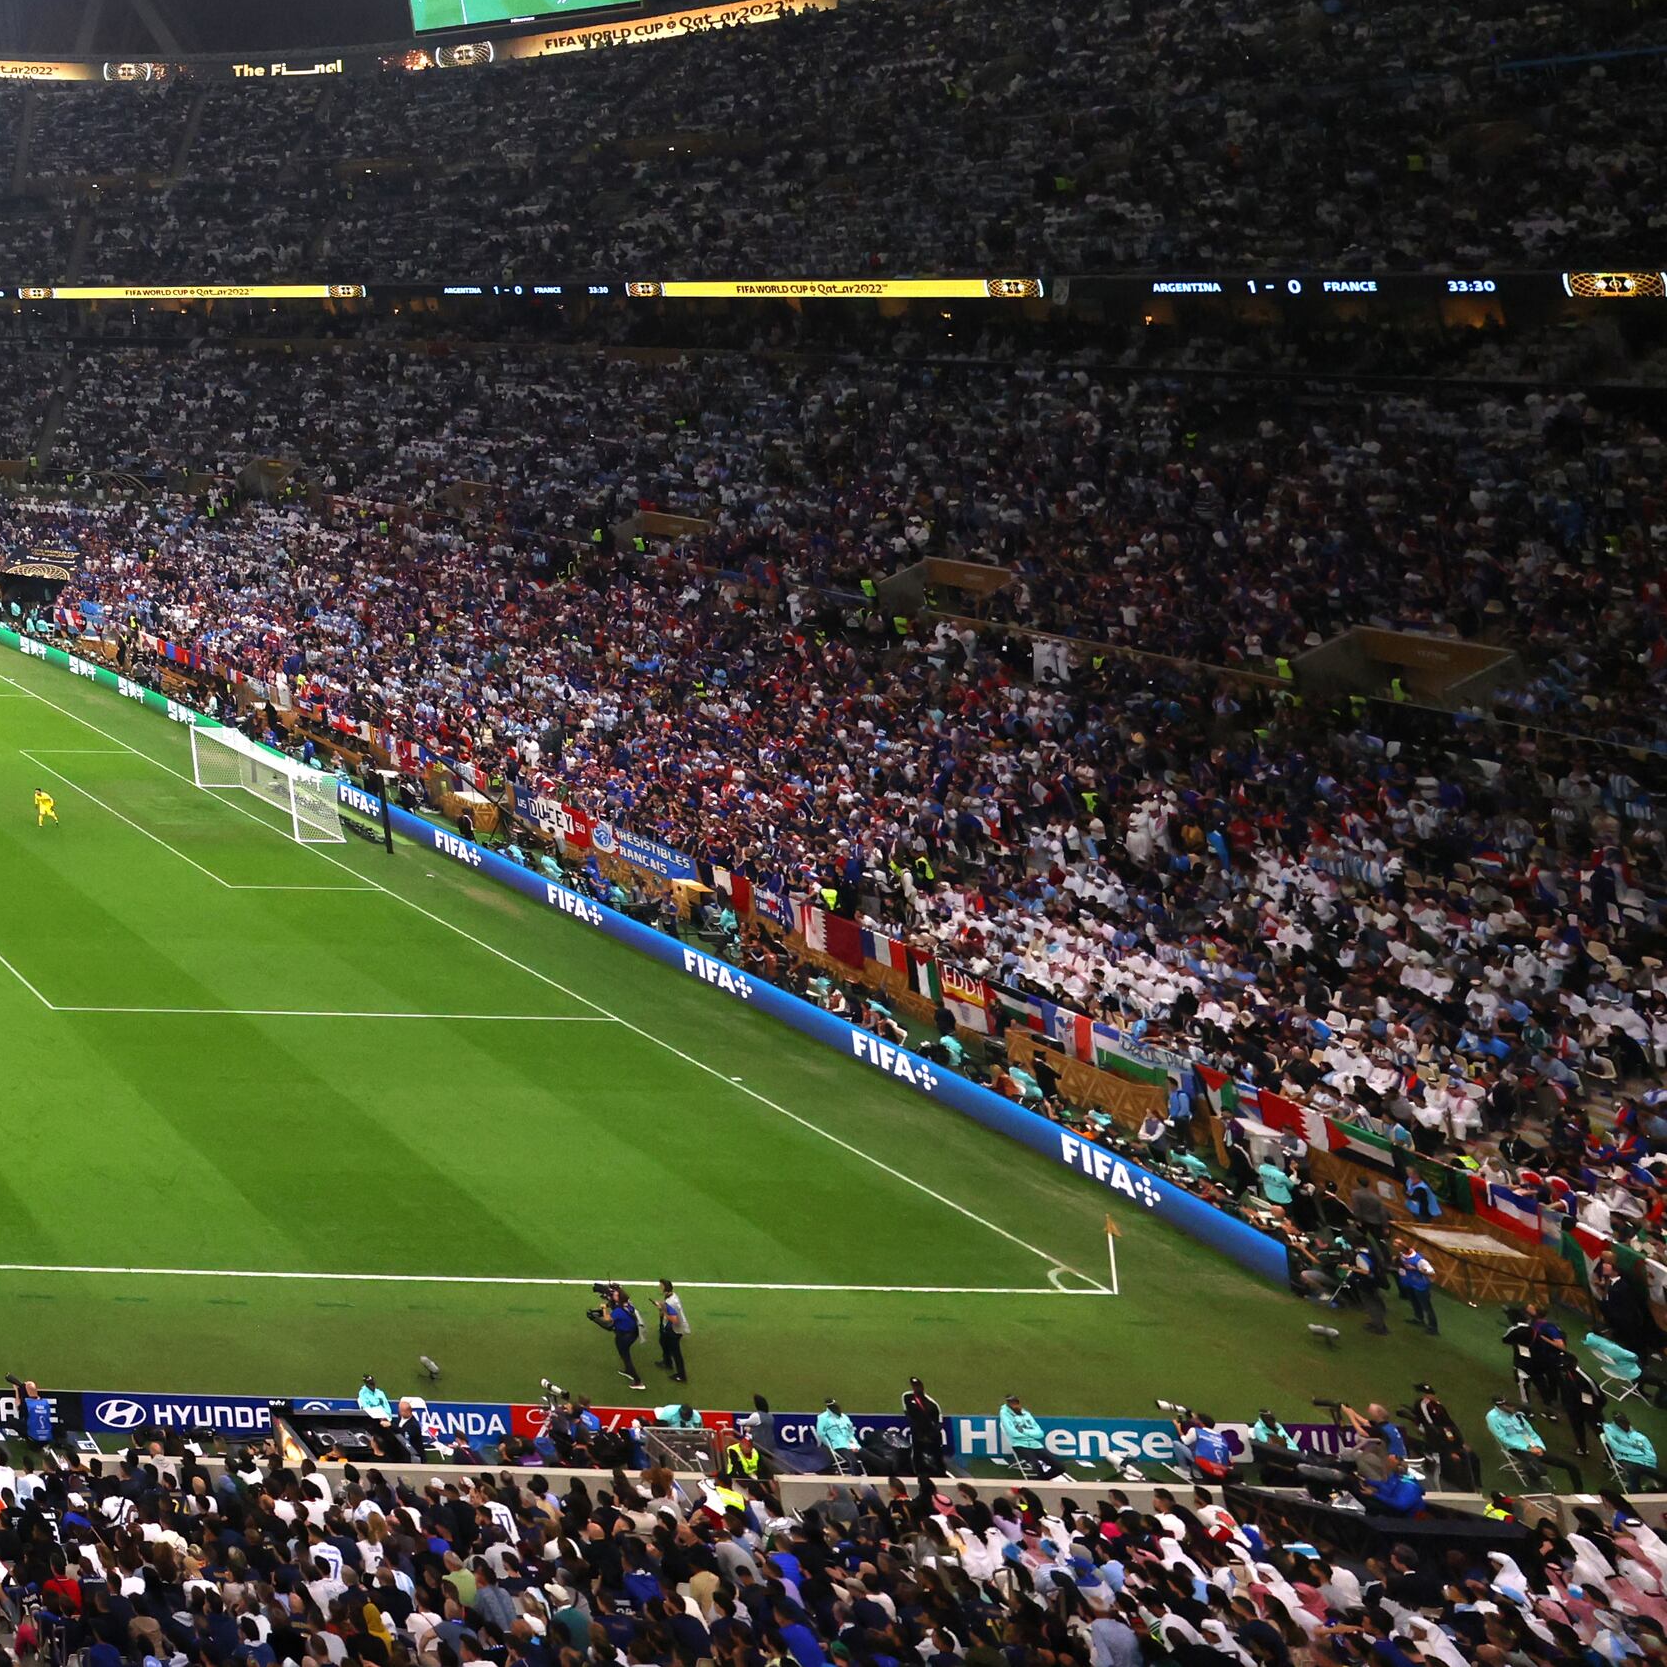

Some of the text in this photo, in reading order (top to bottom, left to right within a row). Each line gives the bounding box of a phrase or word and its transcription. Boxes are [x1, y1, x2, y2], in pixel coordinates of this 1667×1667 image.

[545, 36, 575, 49] FIFA
[576, 28, 631, 45] WORLD
[635, 22, 663, 36] CUP
[233, 65, 265, 77] The
[736, 285, 757, 294] FIFA
[758, 285, 789, 294] WORLD
[790, 285, 808, 294] CUP
[1153, 282, 1221, 293] ARGENTINA
[1247, 281, 1256, 293] 1
[1287, 280, 1301, 293] 0
[1324, 281, 1377, 292] FRANCE
[1447, 281, 1496, 292] 33:30
[154, 1404, 272, 1429] HYUNDA
[960, 1419, 1174, 1459] Hense
